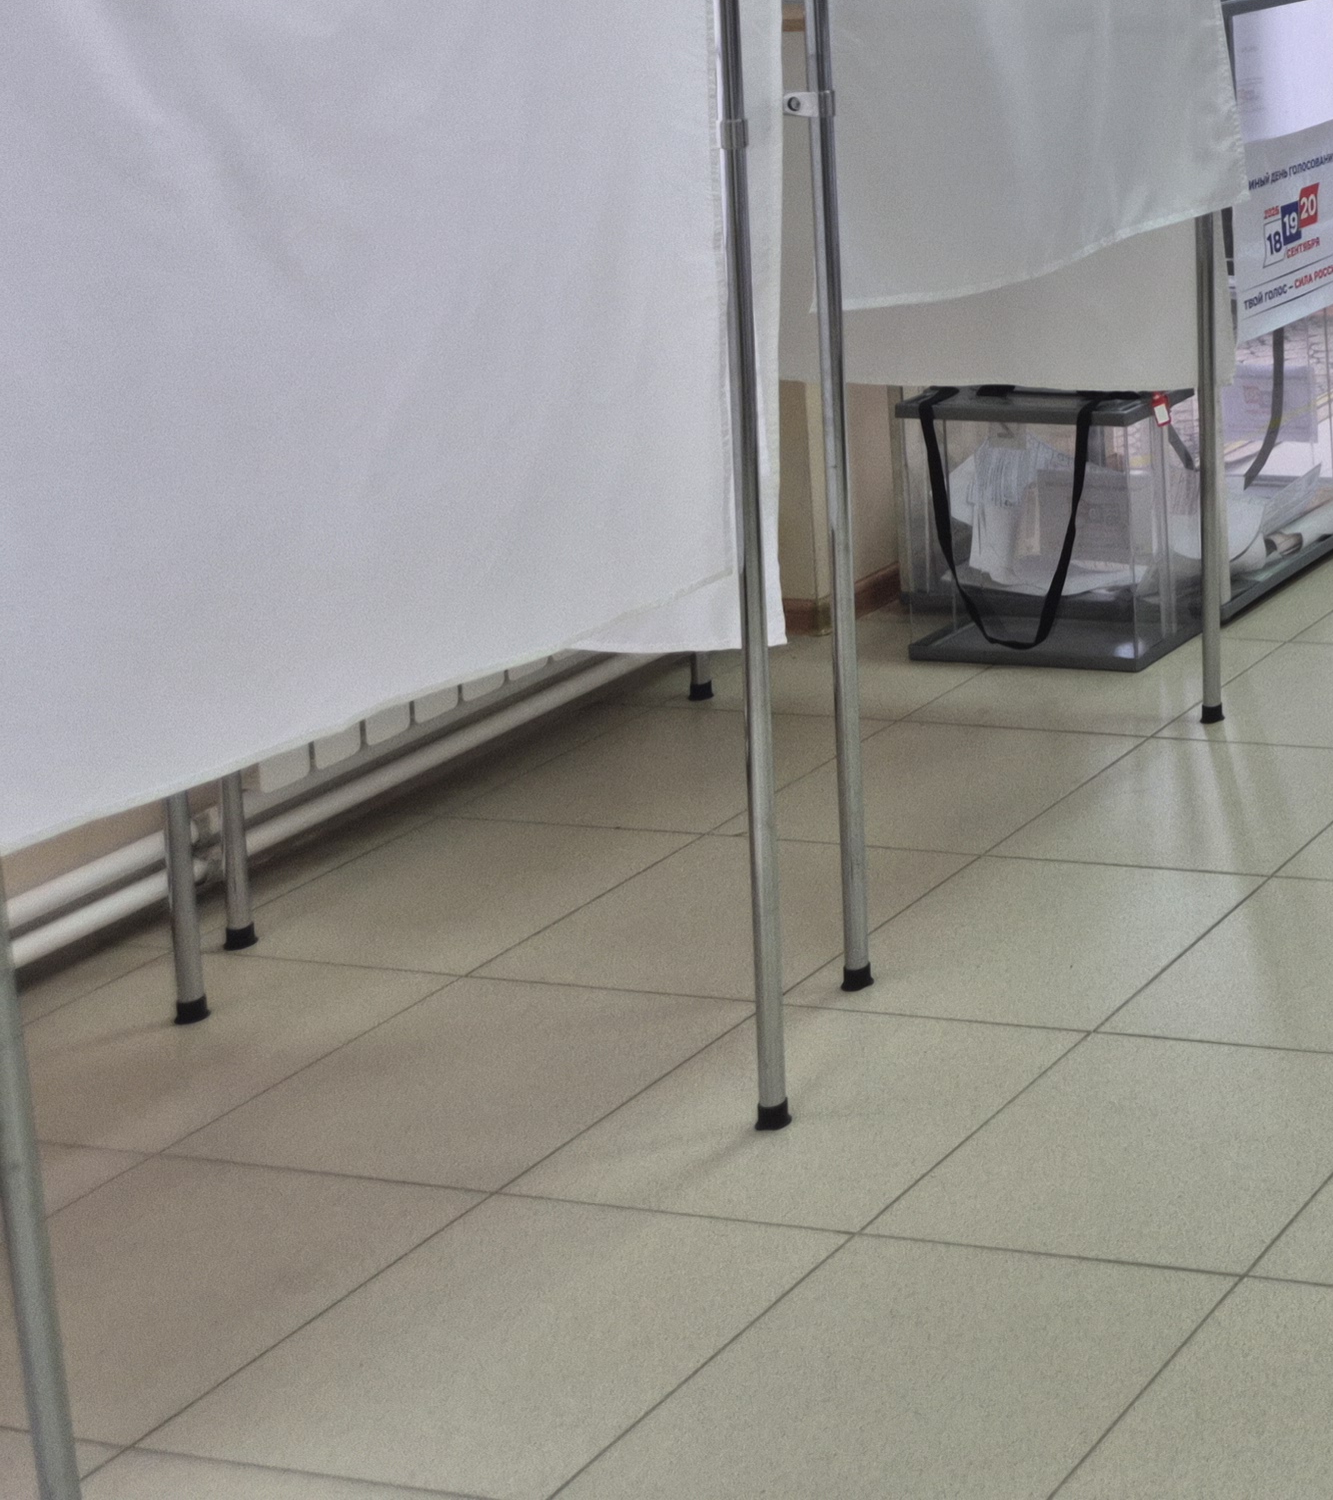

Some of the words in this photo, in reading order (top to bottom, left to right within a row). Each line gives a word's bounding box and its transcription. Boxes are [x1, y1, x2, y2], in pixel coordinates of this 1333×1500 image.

[1270, 169, 1288, 184] ДЕНЬ
[1300, 194, 1317, 219] 20
[1283, 211, 1298, 237] 19
[1266, 230, 1283, 256] 18
[1286, 237, 1320, 259] СЕНТЯБРЯ
[1243, 291, 1264, 311] ТВОЙ
[1264, 284, 1288, 301] ГОЛОС
[1294, 274, 1313, 290] СИЛА
